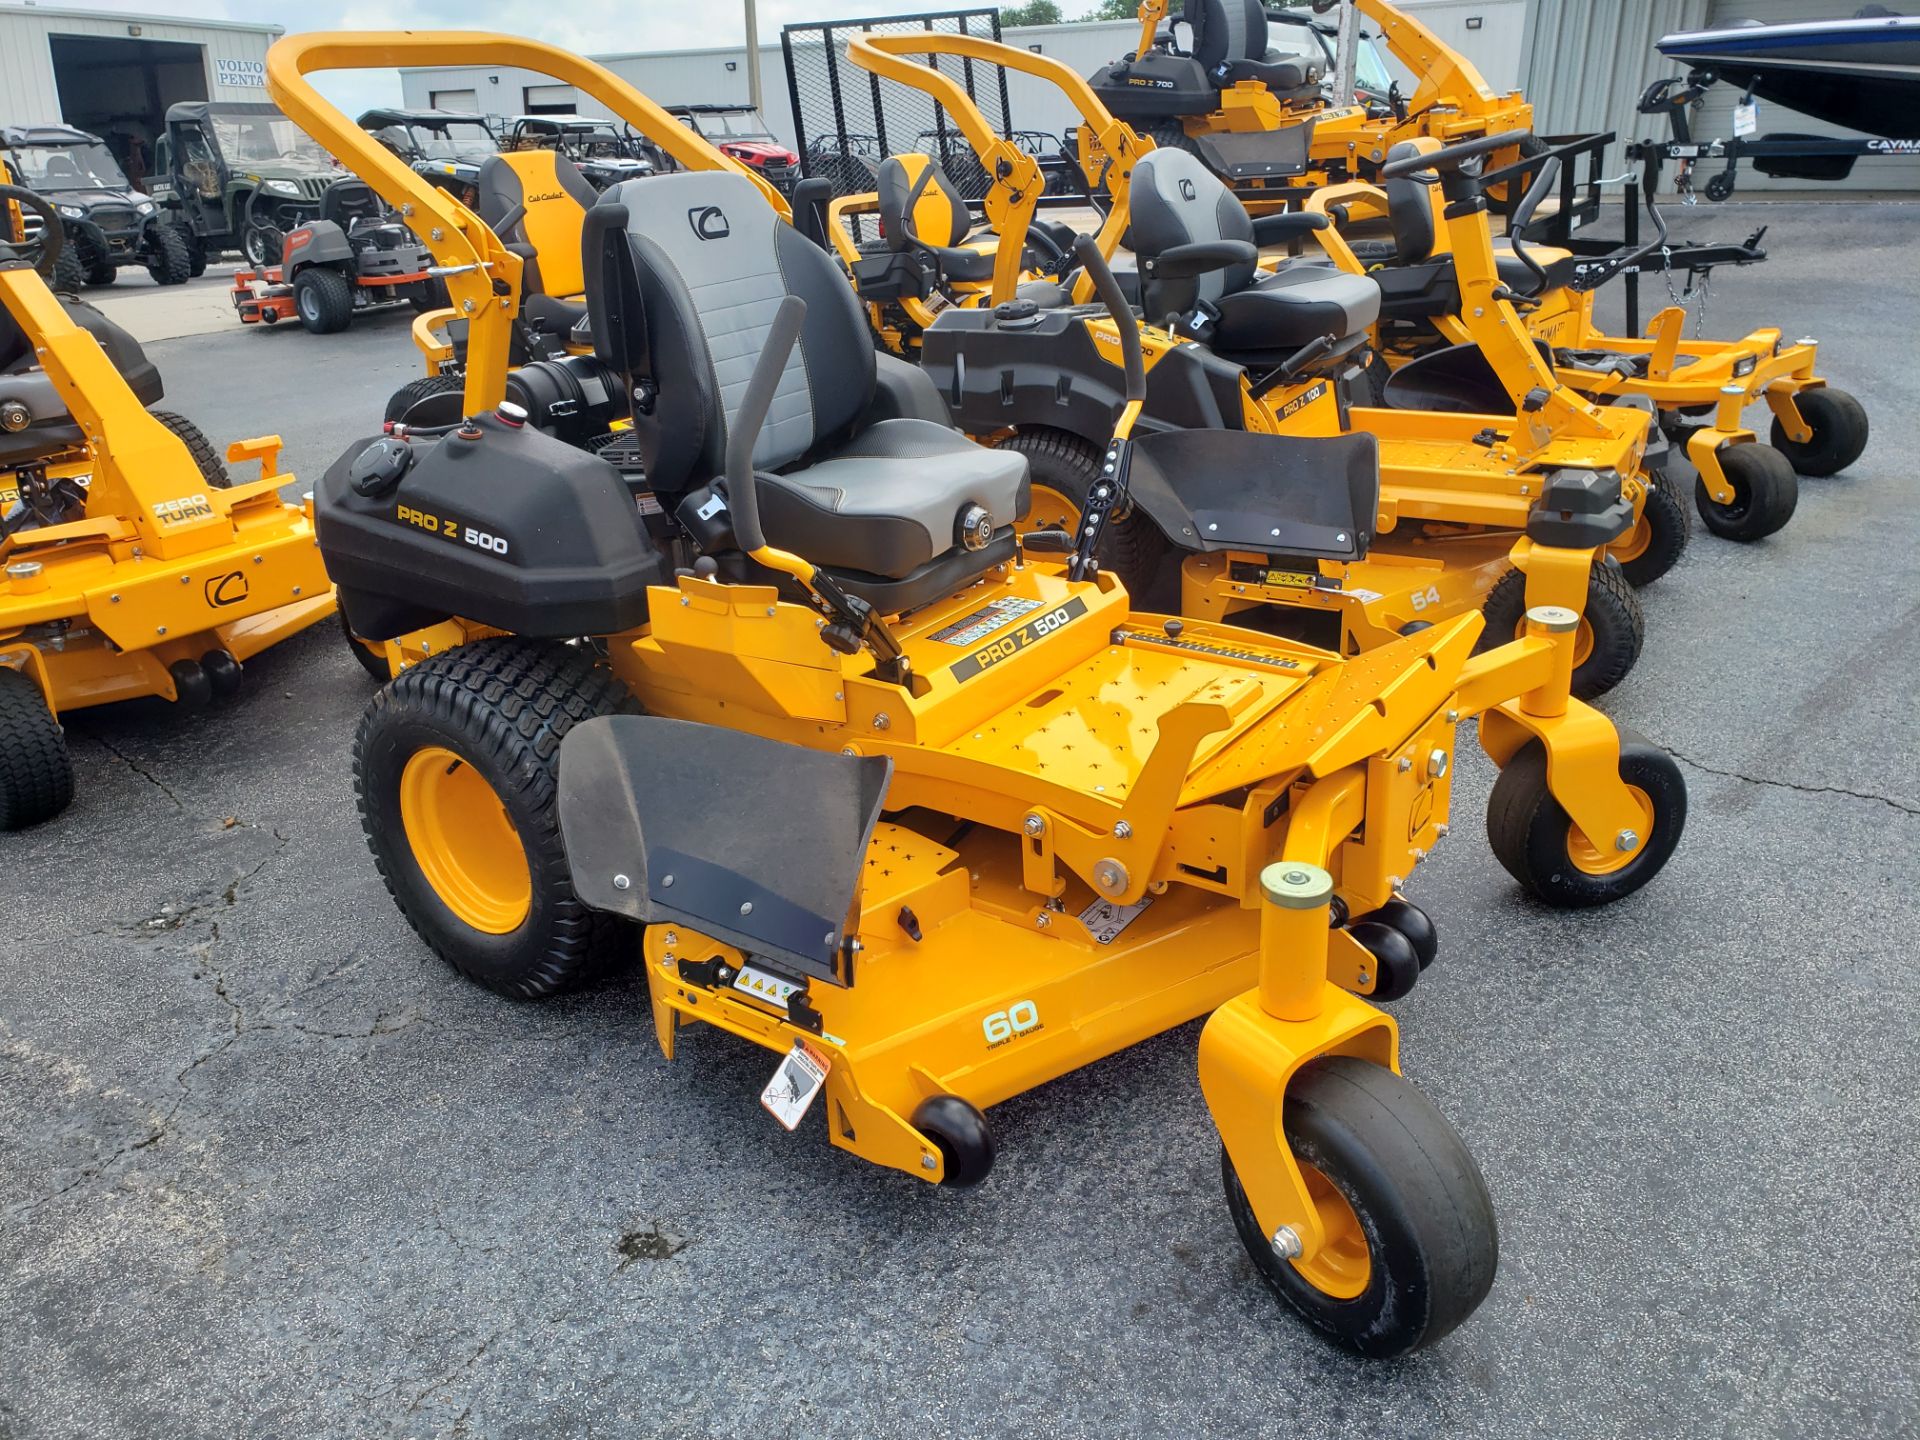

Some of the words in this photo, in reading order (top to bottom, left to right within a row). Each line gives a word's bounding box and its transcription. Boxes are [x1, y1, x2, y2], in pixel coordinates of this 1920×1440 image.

[217, 59, 263, 73] VOLVO
[219, 73, 264, 86] PENTA
[1128, 78, 1147, 86] PRO
[1156, 80, 1174, 88] 700
[528, 195, 541, 203] Cub
[541, 191, 564, 200] Cadet
[1095, 330, 1121, 345] PRO
[1283, 399, 1299, 416] PRO
[1299, 395, 1306, 408] Z
[1306, 386, 1320, 401] 100
[152, 494, 208, 516] ZERO
[157, 503, 213, 524] TURN
[397, 504, 438, 532] PRO
[443, 520, 458, 538] Z
[465, 527, 508, 554] 500
[1410, 586, 1441, 612] 54
[975, 637, 1017, 669] PRO
[1016, 628, 1034, 646] Z
[1033, 608, 1070, 636] 500
[983, 1000, 1039, 1043] 60
[986, 1037, 1011, 1051] TRIPLE
[1019, 1023, 1045, 1038] GAUGE
[808, 1049, 829, 1071] WARNING
